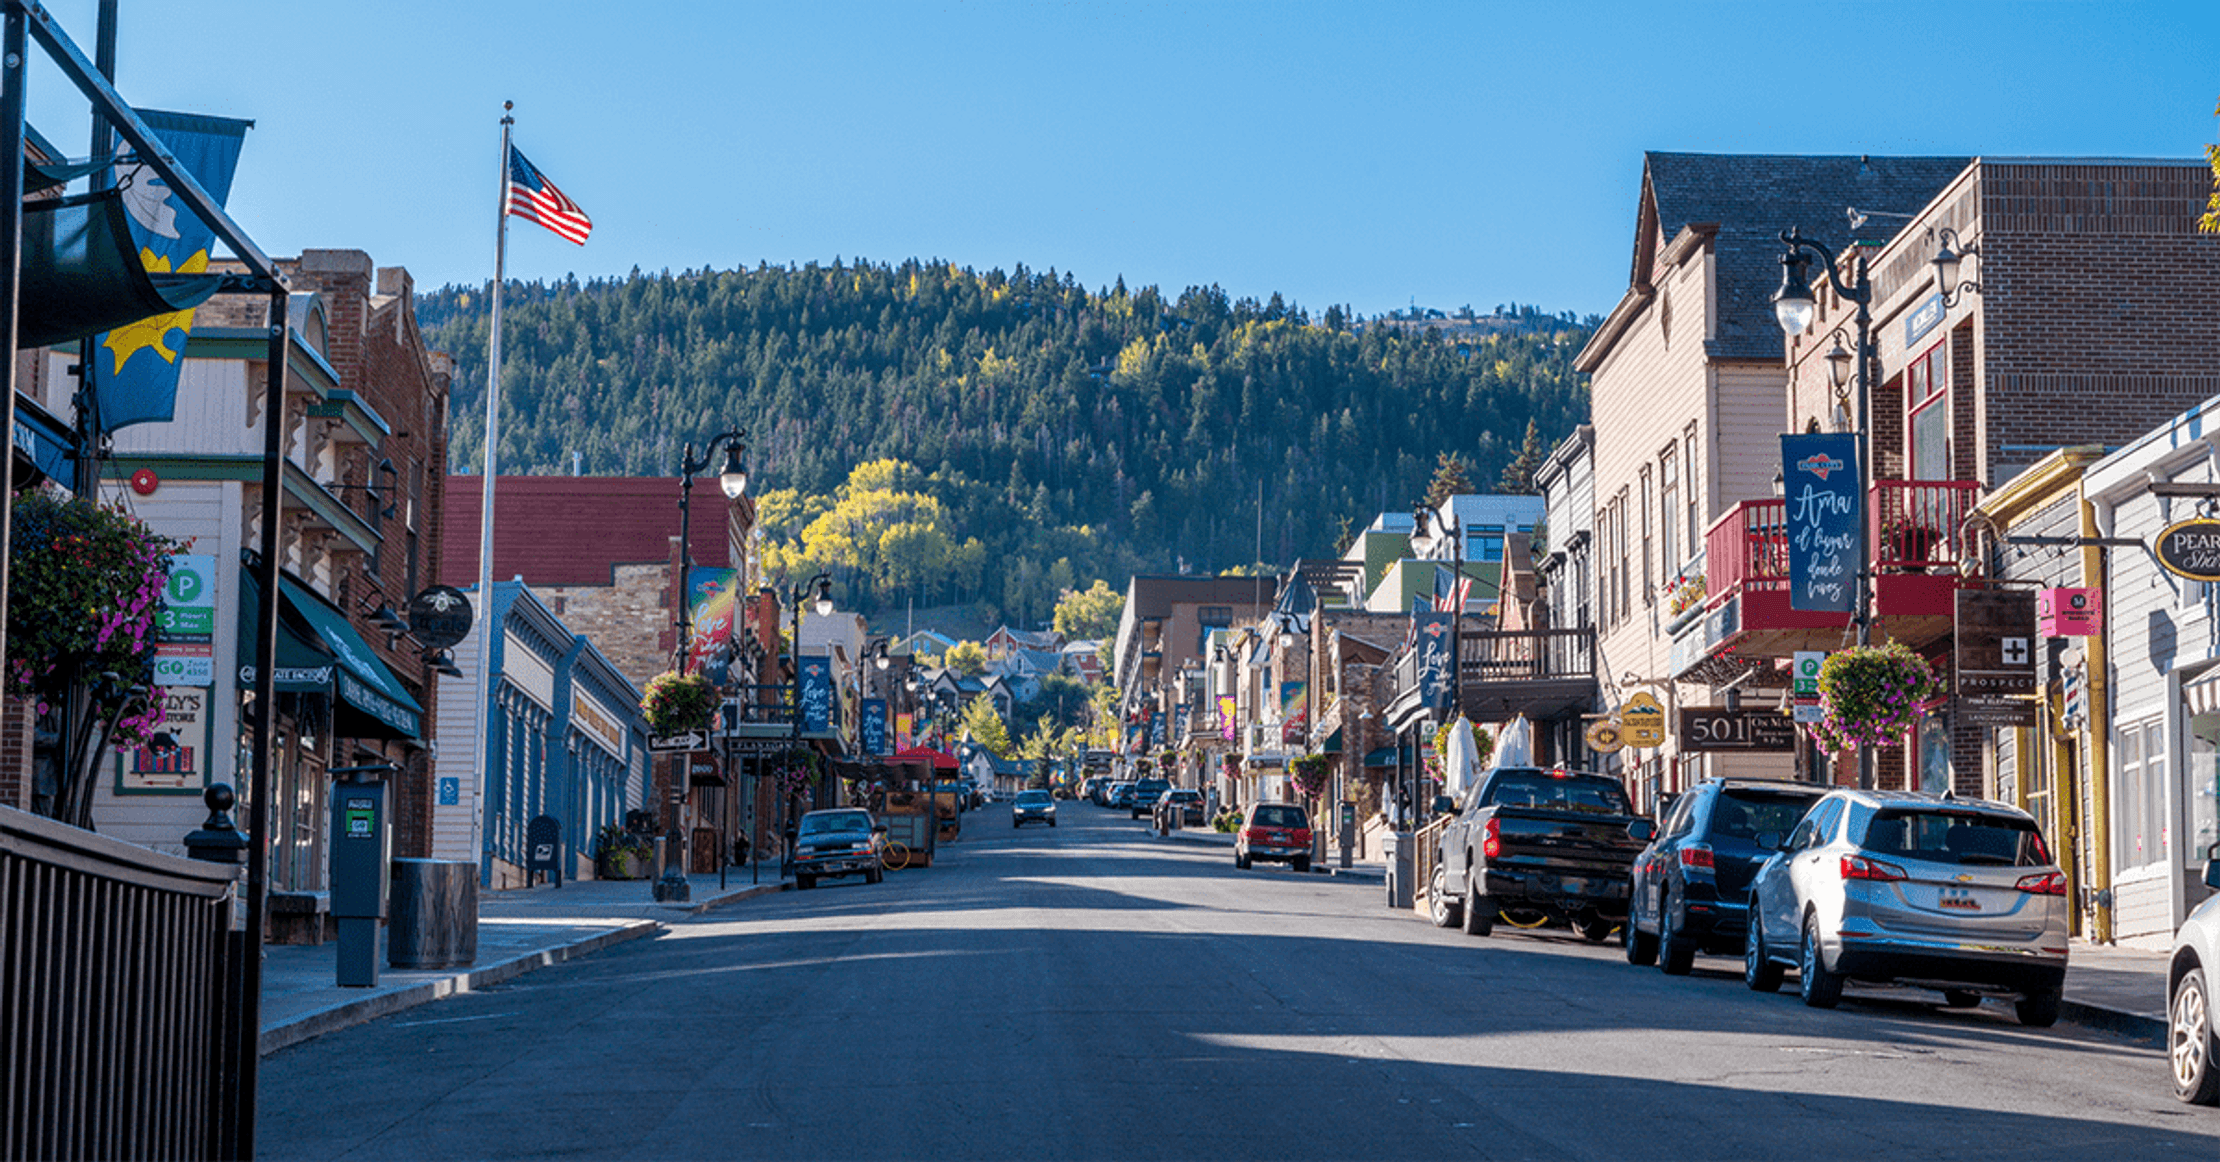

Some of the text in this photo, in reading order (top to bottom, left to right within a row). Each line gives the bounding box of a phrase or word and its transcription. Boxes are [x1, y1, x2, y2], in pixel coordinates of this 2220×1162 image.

[1793, 484, 1852, 528] Ama
[179, 575, 195, 597] P
[163, 611, 176, 629] 3
[1960, 678, 2034, 688] PROSPECT
[1692, 718, 1744, 741] 501
